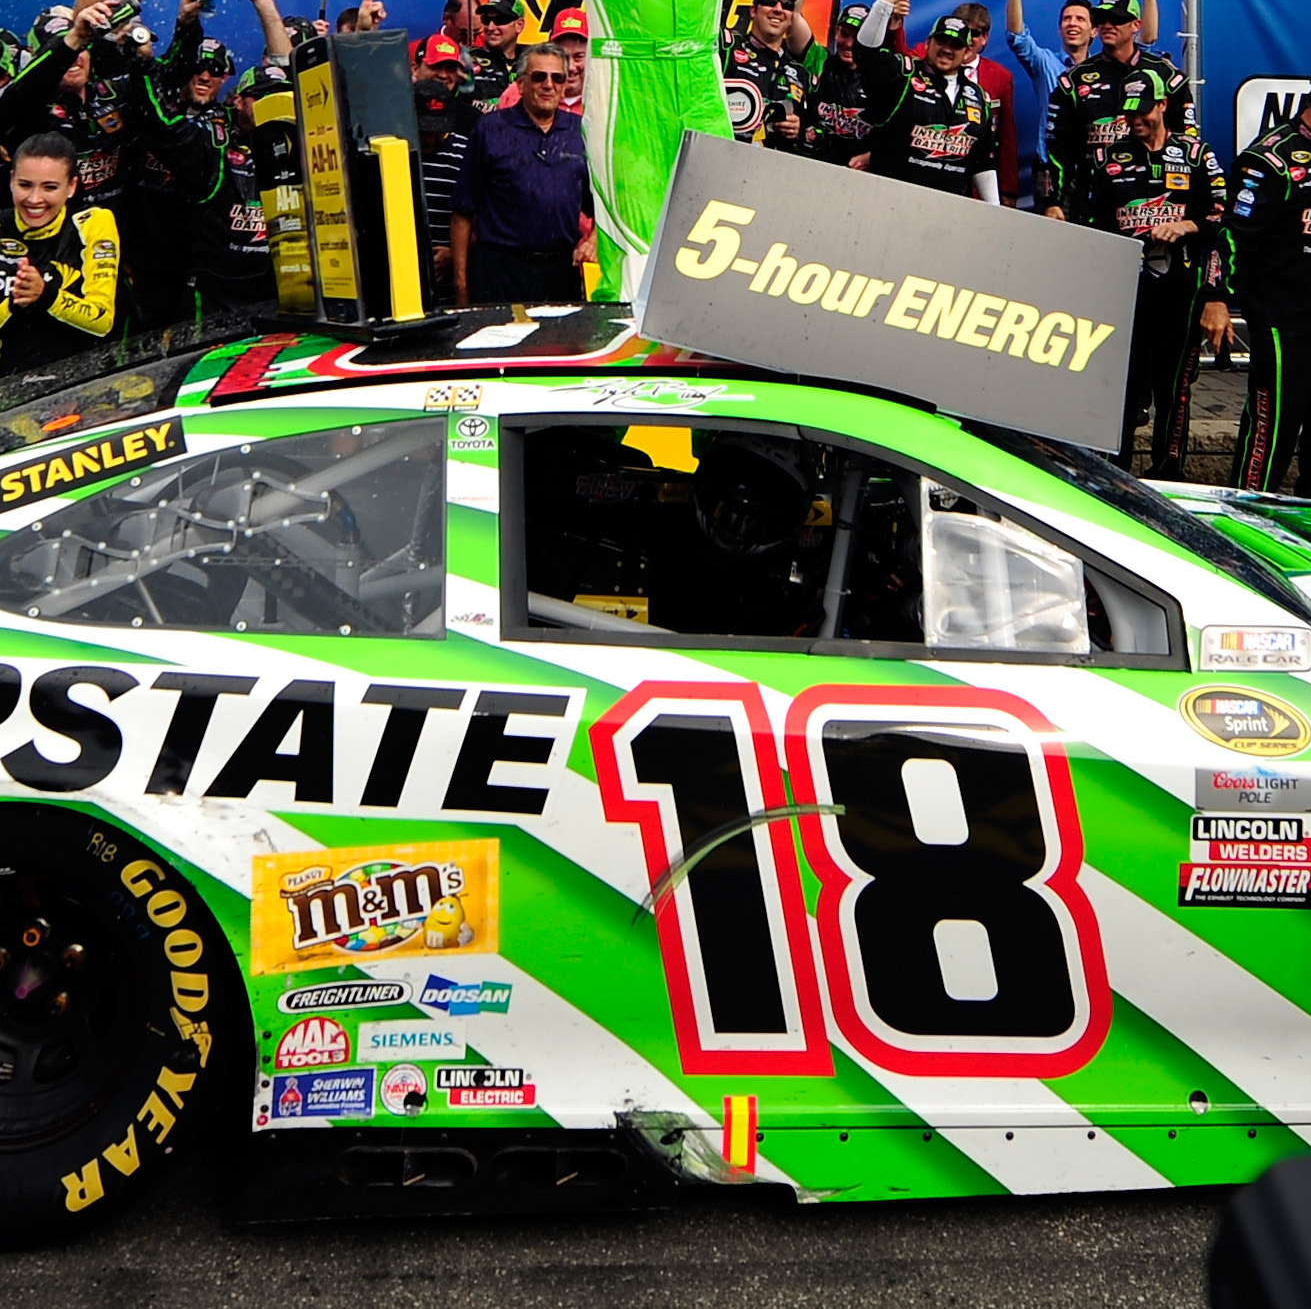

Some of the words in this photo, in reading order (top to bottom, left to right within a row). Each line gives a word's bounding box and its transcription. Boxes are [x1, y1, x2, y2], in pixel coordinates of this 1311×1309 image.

[675, 200, 895, 319] 5-hour
[884, 275, 1116, 375] ENERGY
[452, 440, 494, 450] TOYOTA
[0, 422, 175, 502] STANLEY
[1244, 633, 1293, 650] NASCAR
[1215, 700, 1258, 715] NASCAR
[1224, 716, 1268, 735] Sprint
[1212, 771, 1255, 790] Coors
[1256, 778, 1299, 791] LIGHT
[1239, 792, 1271, 804] POLE
[1198, 820, 1298, 840] LINCOLN
[1220, 844, 1308, 861] WELDERS
[287, 868, 323, 887] PEANUT
[614, 699, 1088, 1053] 18
[1185, 868, 1311, 900] FLOWMASTER
[291, 985, 399, 1008] FREIGHTLINER
[422, 988, 509, 1004] DOOSAN
[280, 1020, 346, 1054] MAC
[371, 1032, 453, 1049] SIEMENS
[279, 1052, 345, 1067] TOOLS
[312, 1077, 365, 1092] SHERWIN
[307, 1090, 366, 1104] WILLIAMS
[461, 1090, 524, 1104] ELECTRIC
